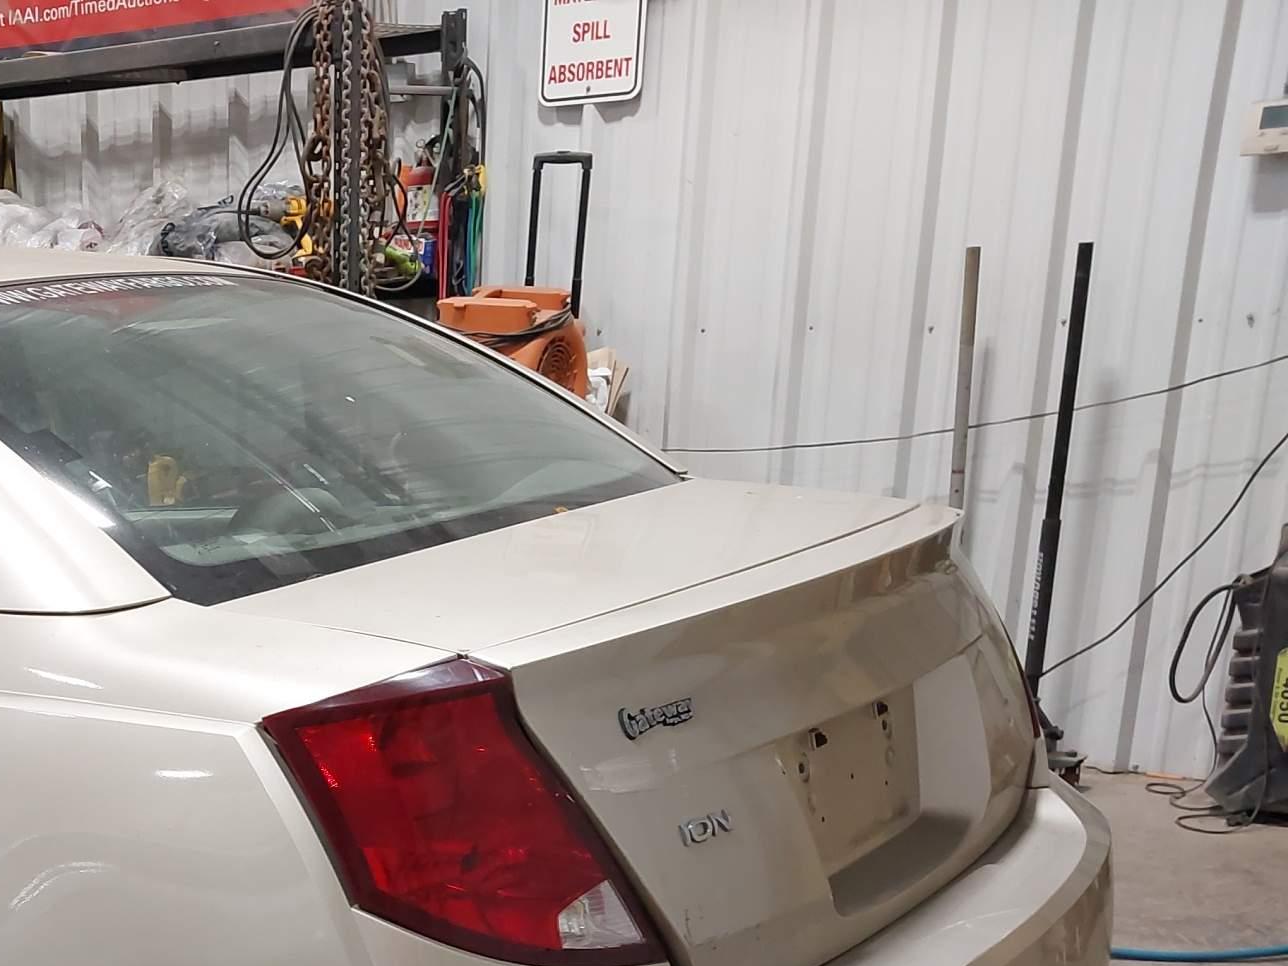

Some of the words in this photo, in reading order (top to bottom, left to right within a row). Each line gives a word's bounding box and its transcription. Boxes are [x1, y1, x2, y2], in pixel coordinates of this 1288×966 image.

[572, 20, 611, 42] SPILL
[548, 57, 633, 84] ABSORBENT
[678, 809, 732, 847] ION
